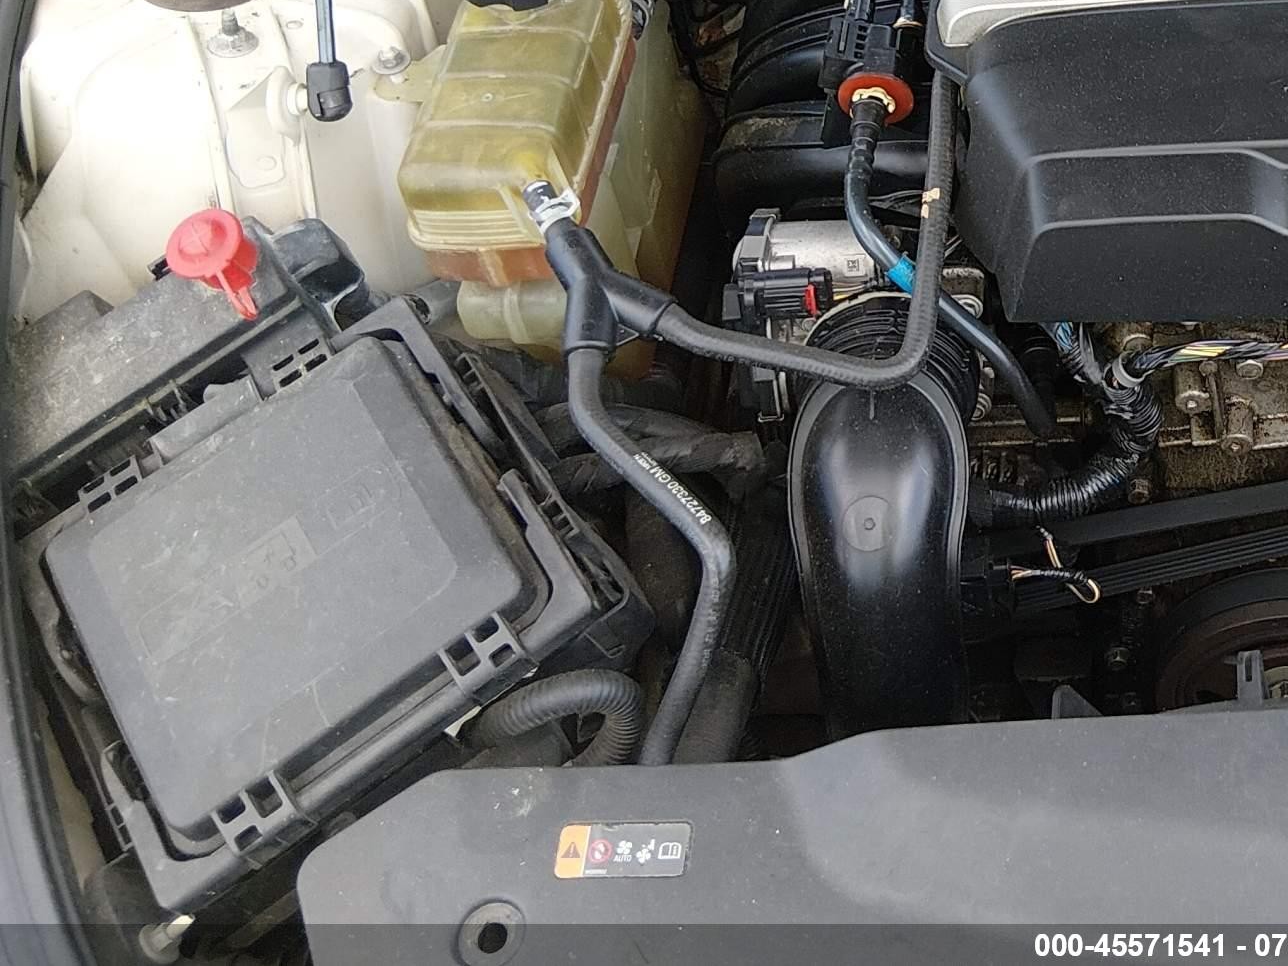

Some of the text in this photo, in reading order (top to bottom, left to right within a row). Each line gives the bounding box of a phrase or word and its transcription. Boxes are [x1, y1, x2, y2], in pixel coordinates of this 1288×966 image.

[649, 466, 712, 525] 84727330 GM
[613, 855, 632, 863] AUTO
